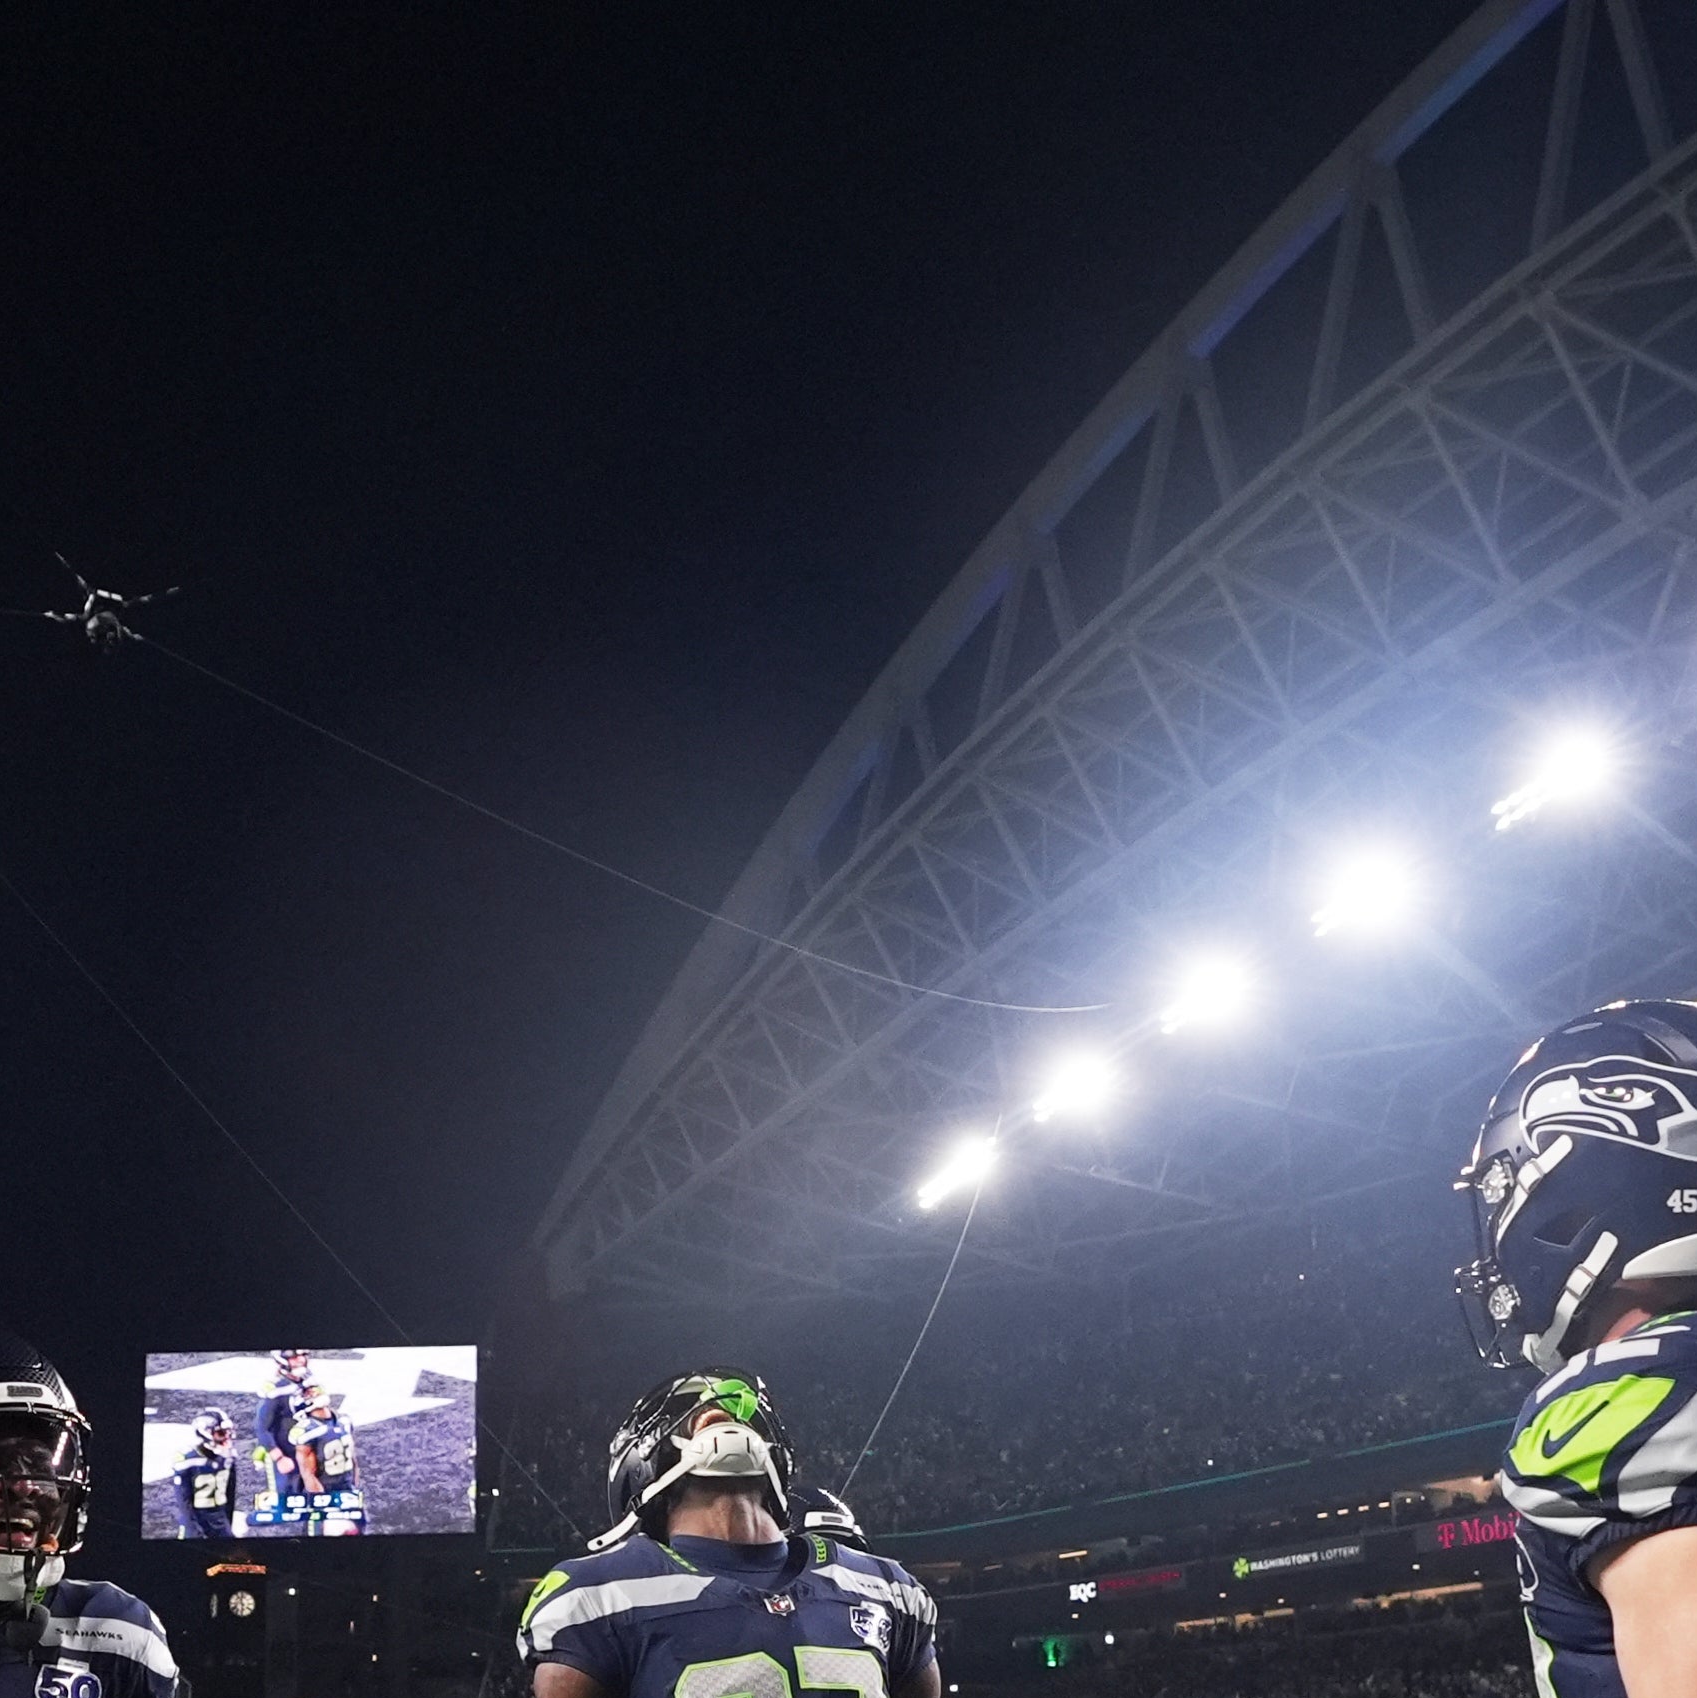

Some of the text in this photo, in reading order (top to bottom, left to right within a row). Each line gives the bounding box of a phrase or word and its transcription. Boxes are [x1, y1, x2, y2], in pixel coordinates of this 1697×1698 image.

[1461, 1511, 1521, 1546] Mobi
[1069, 1582, 1097, 1603] EQC
[55, 1626, 124, 1642] SEAHAWKS
